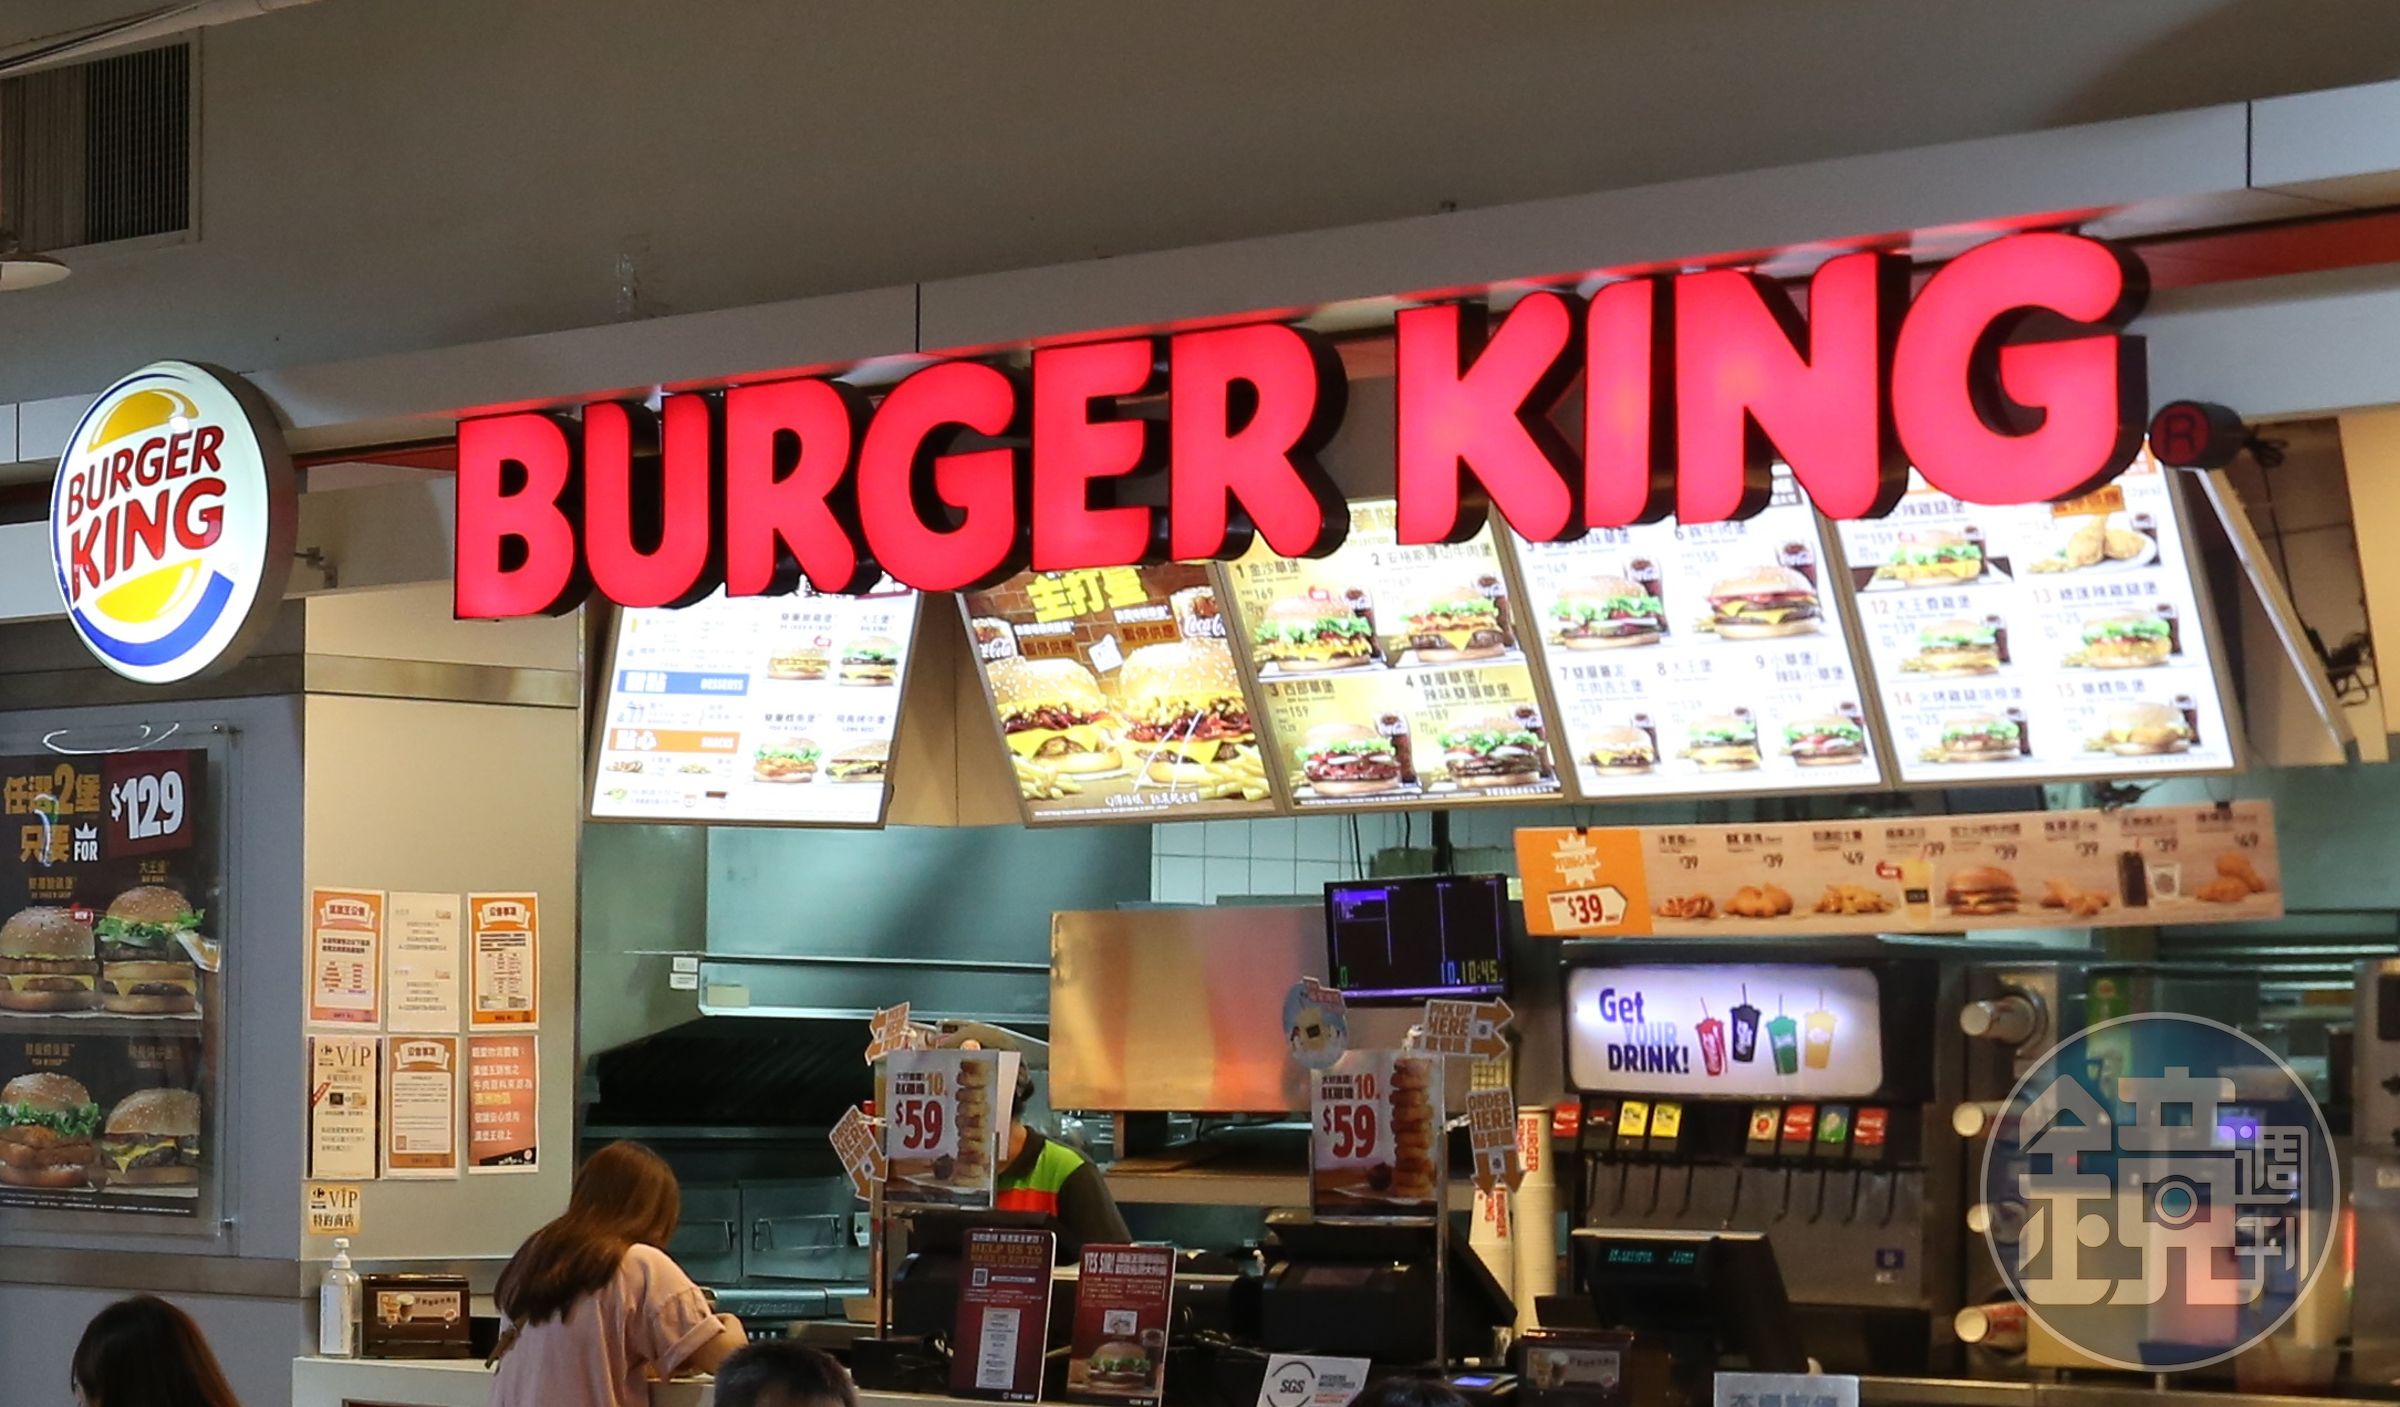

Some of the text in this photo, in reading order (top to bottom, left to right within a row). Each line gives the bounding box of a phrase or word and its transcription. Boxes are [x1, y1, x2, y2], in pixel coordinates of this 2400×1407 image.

[455, 232, 2132, 620] BURGER KING
[67, 425, 225, 526] BURGER
[71, 477, 226, 603] KING
[1371, 552, 1381, 566] 2
[1235, 563, 1245, 579] 1
[1871, 599, 1889, 615] 12
[1657, 661, 1667, 676] 8
[1755, 655, 1765, 669] 9
[1405, 674, 1415, 688] 4
[1560, 666, 1568, 680] 7
[1268, 682, 1279, 697] 3
[1893, 691, 1912, 706] 14
[1289, 705, 1309, 718] 159
[110, 770, 185, 841] $129
[74, 841, 98, 861] FOR
[1763, 853, 1784, 868] $39
[1679, 855, 1699, 870] $39
[1567, 893, 1604, 924] $39
[1599, 988, 1645, 1024] Get
[1427, 1016, 1471, 1037] HERE
[1624, 1021, 1678, 1047] YOUR
[1607, 1043, 1690, 1075] DRINK!
[895, 1100, 944, 1151] $59
[1472, 1106, 1513, 1133] HERE
[1322, 1103, 1377, 1159] $59
[1527, 1118, 1539, 1173] BURGER
[329, 1187, 359, 1208] VIP
[1279, 1379, 1306, 1394] SGS
